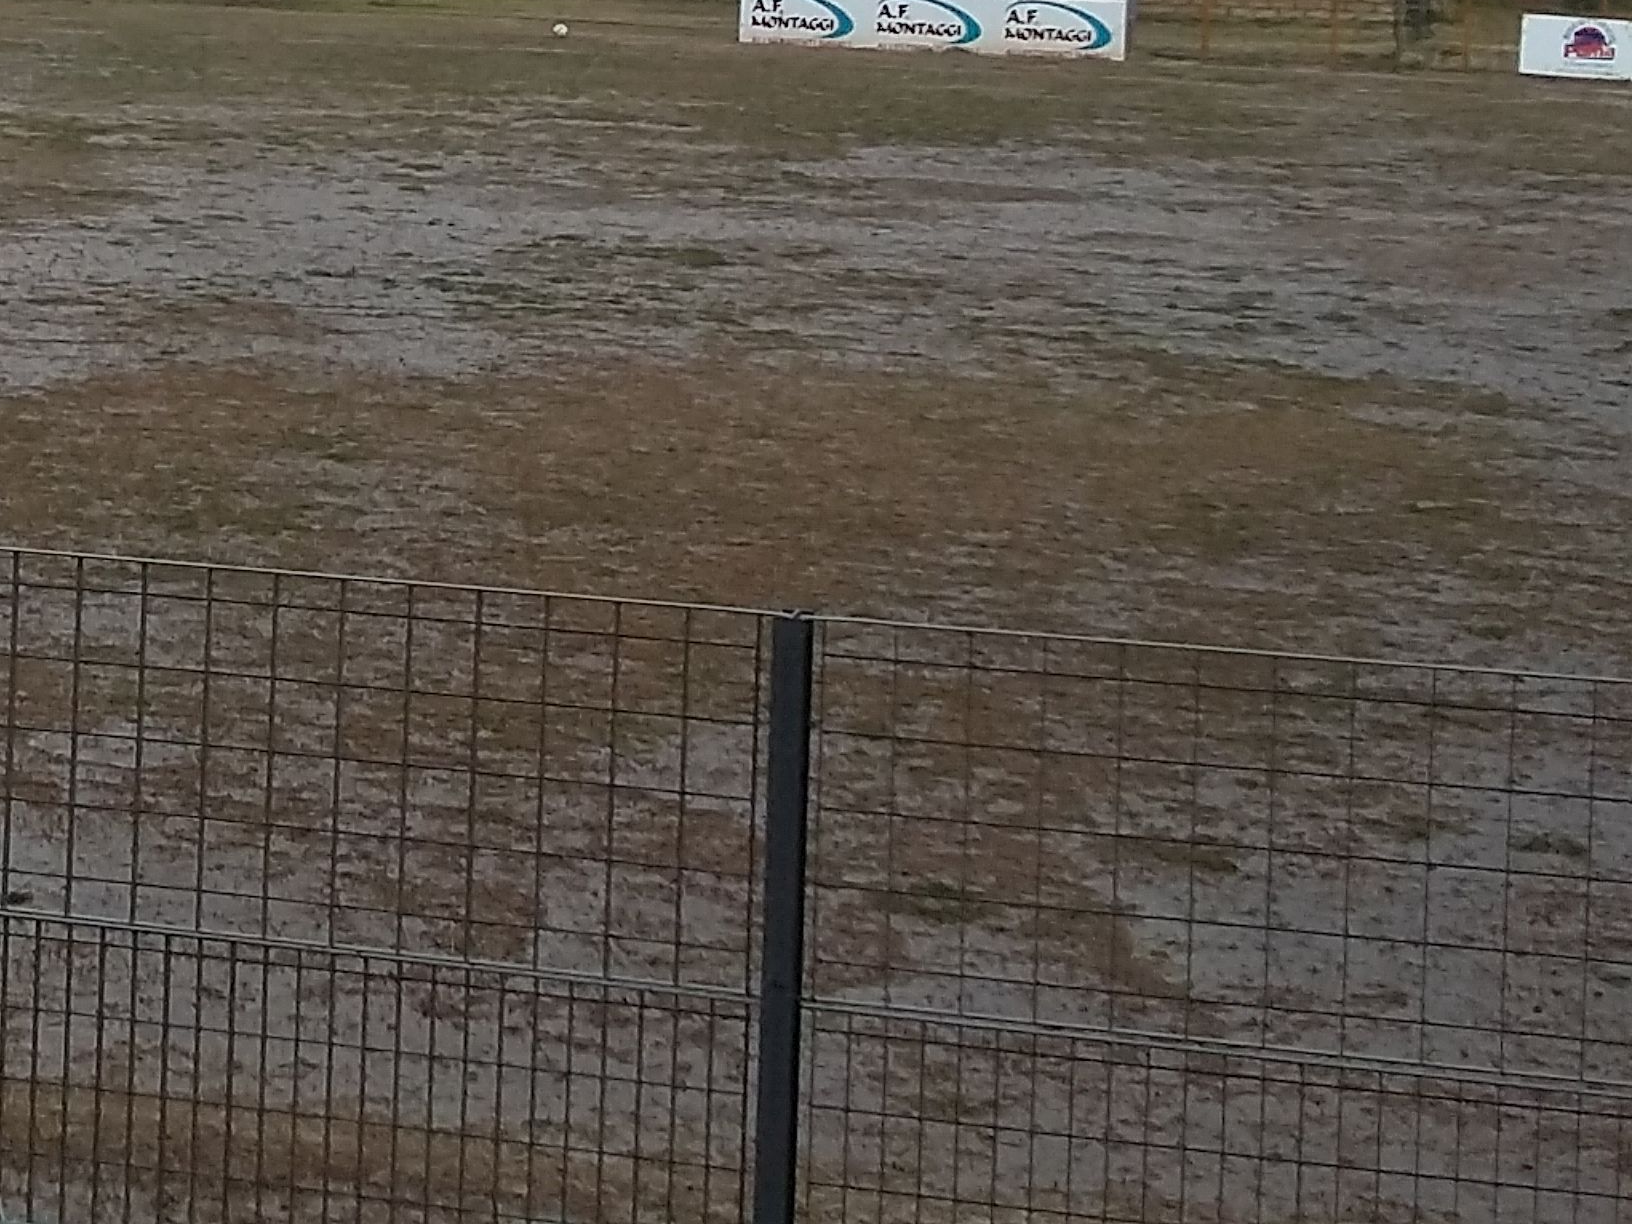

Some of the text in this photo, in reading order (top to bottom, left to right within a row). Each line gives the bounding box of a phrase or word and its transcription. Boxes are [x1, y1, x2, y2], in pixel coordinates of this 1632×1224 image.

[751, 15, 835, 31] MONTAGGI
[876, 21, 962, 37] MONTAGGI
[1004, 27, 1092, 42] MONTAGGI
